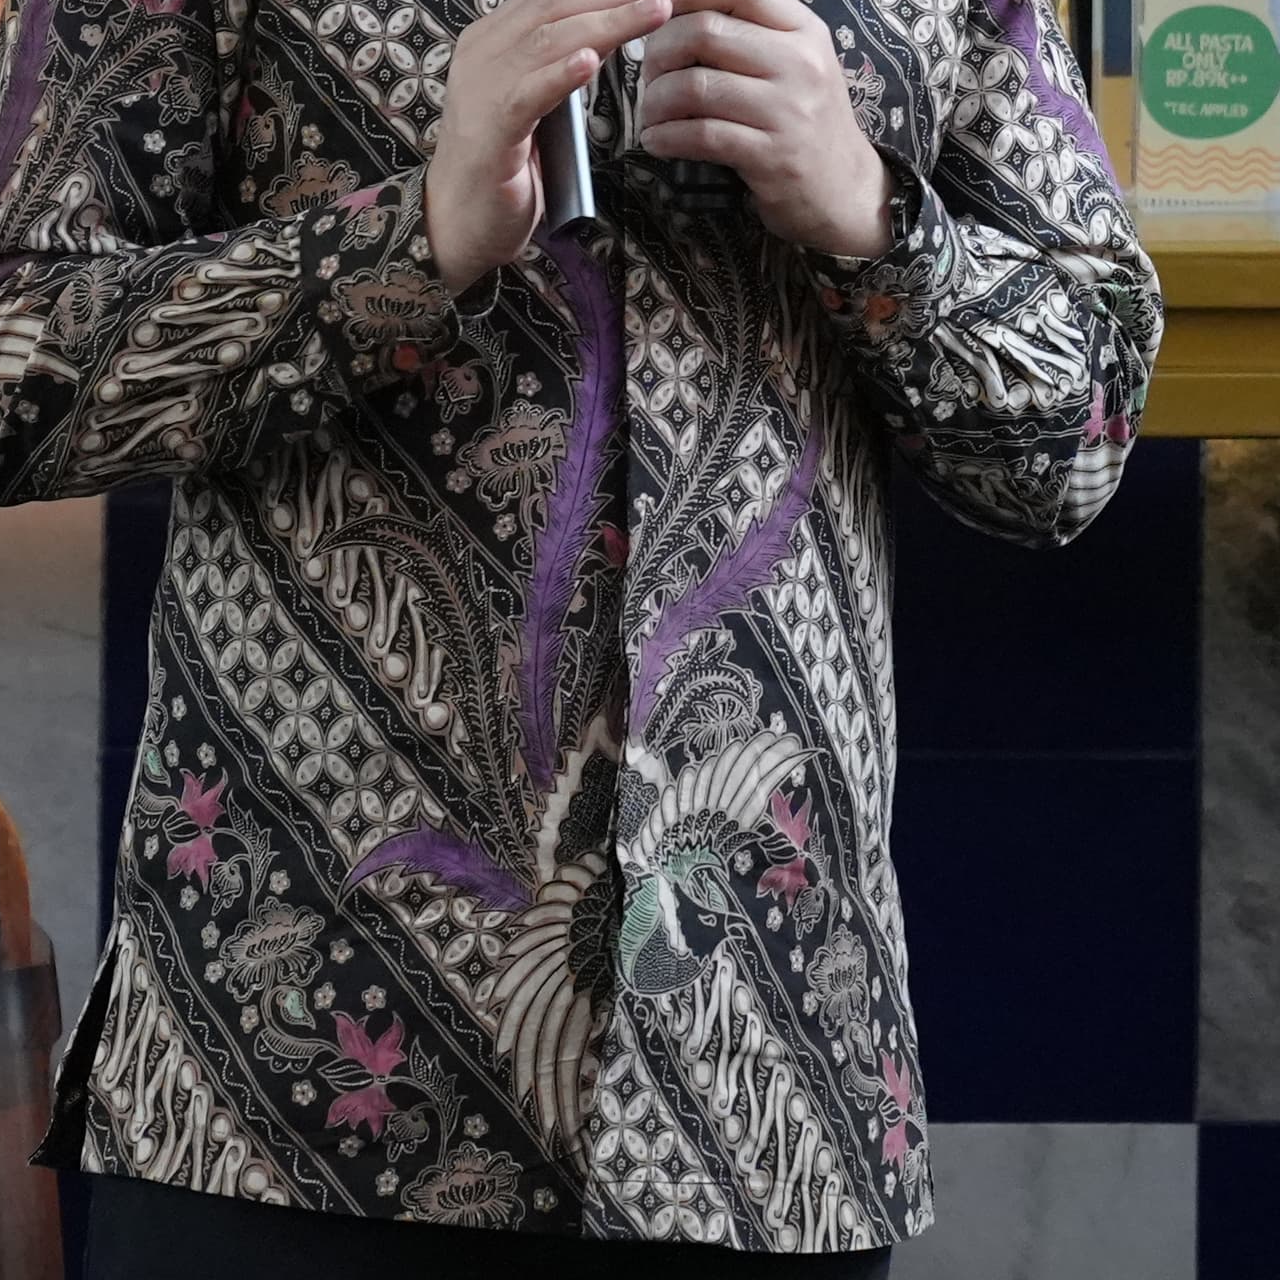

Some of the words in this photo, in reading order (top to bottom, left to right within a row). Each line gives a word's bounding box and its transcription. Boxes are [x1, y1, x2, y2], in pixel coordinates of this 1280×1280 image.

[1163, 32, 1194, 52] ALL
[1198, 33, 1254, 54] PASTA
[1182, 51, 1229, 70] ONLY
